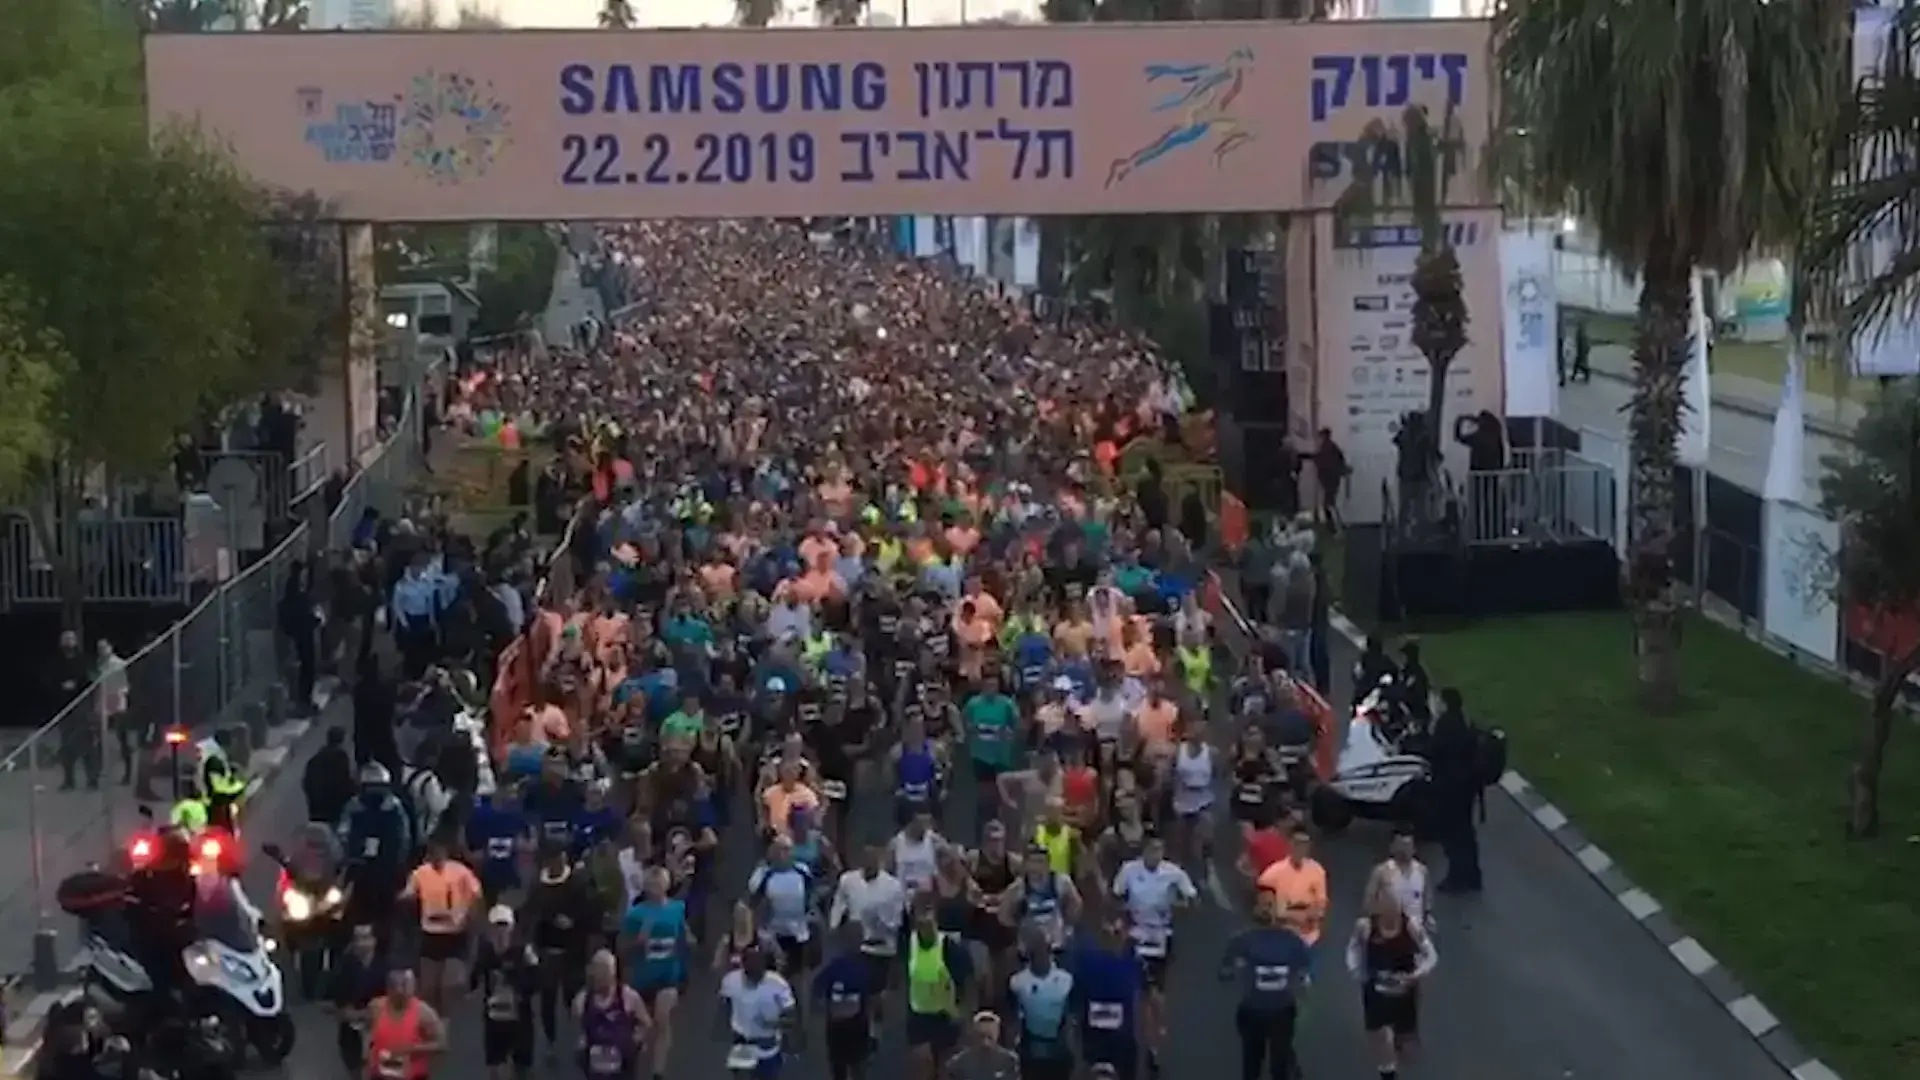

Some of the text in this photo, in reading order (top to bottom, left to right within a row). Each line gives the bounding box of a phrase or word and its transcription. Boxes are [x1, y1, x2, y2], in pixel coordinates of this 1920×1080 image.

[560, 62, 887, 114] SAMSUNG
[914, 60, 1073, 118] מרתון
[1311, 53, 1468, 122] זינוק
[561, 131, 815, 184] 22.2.2019
